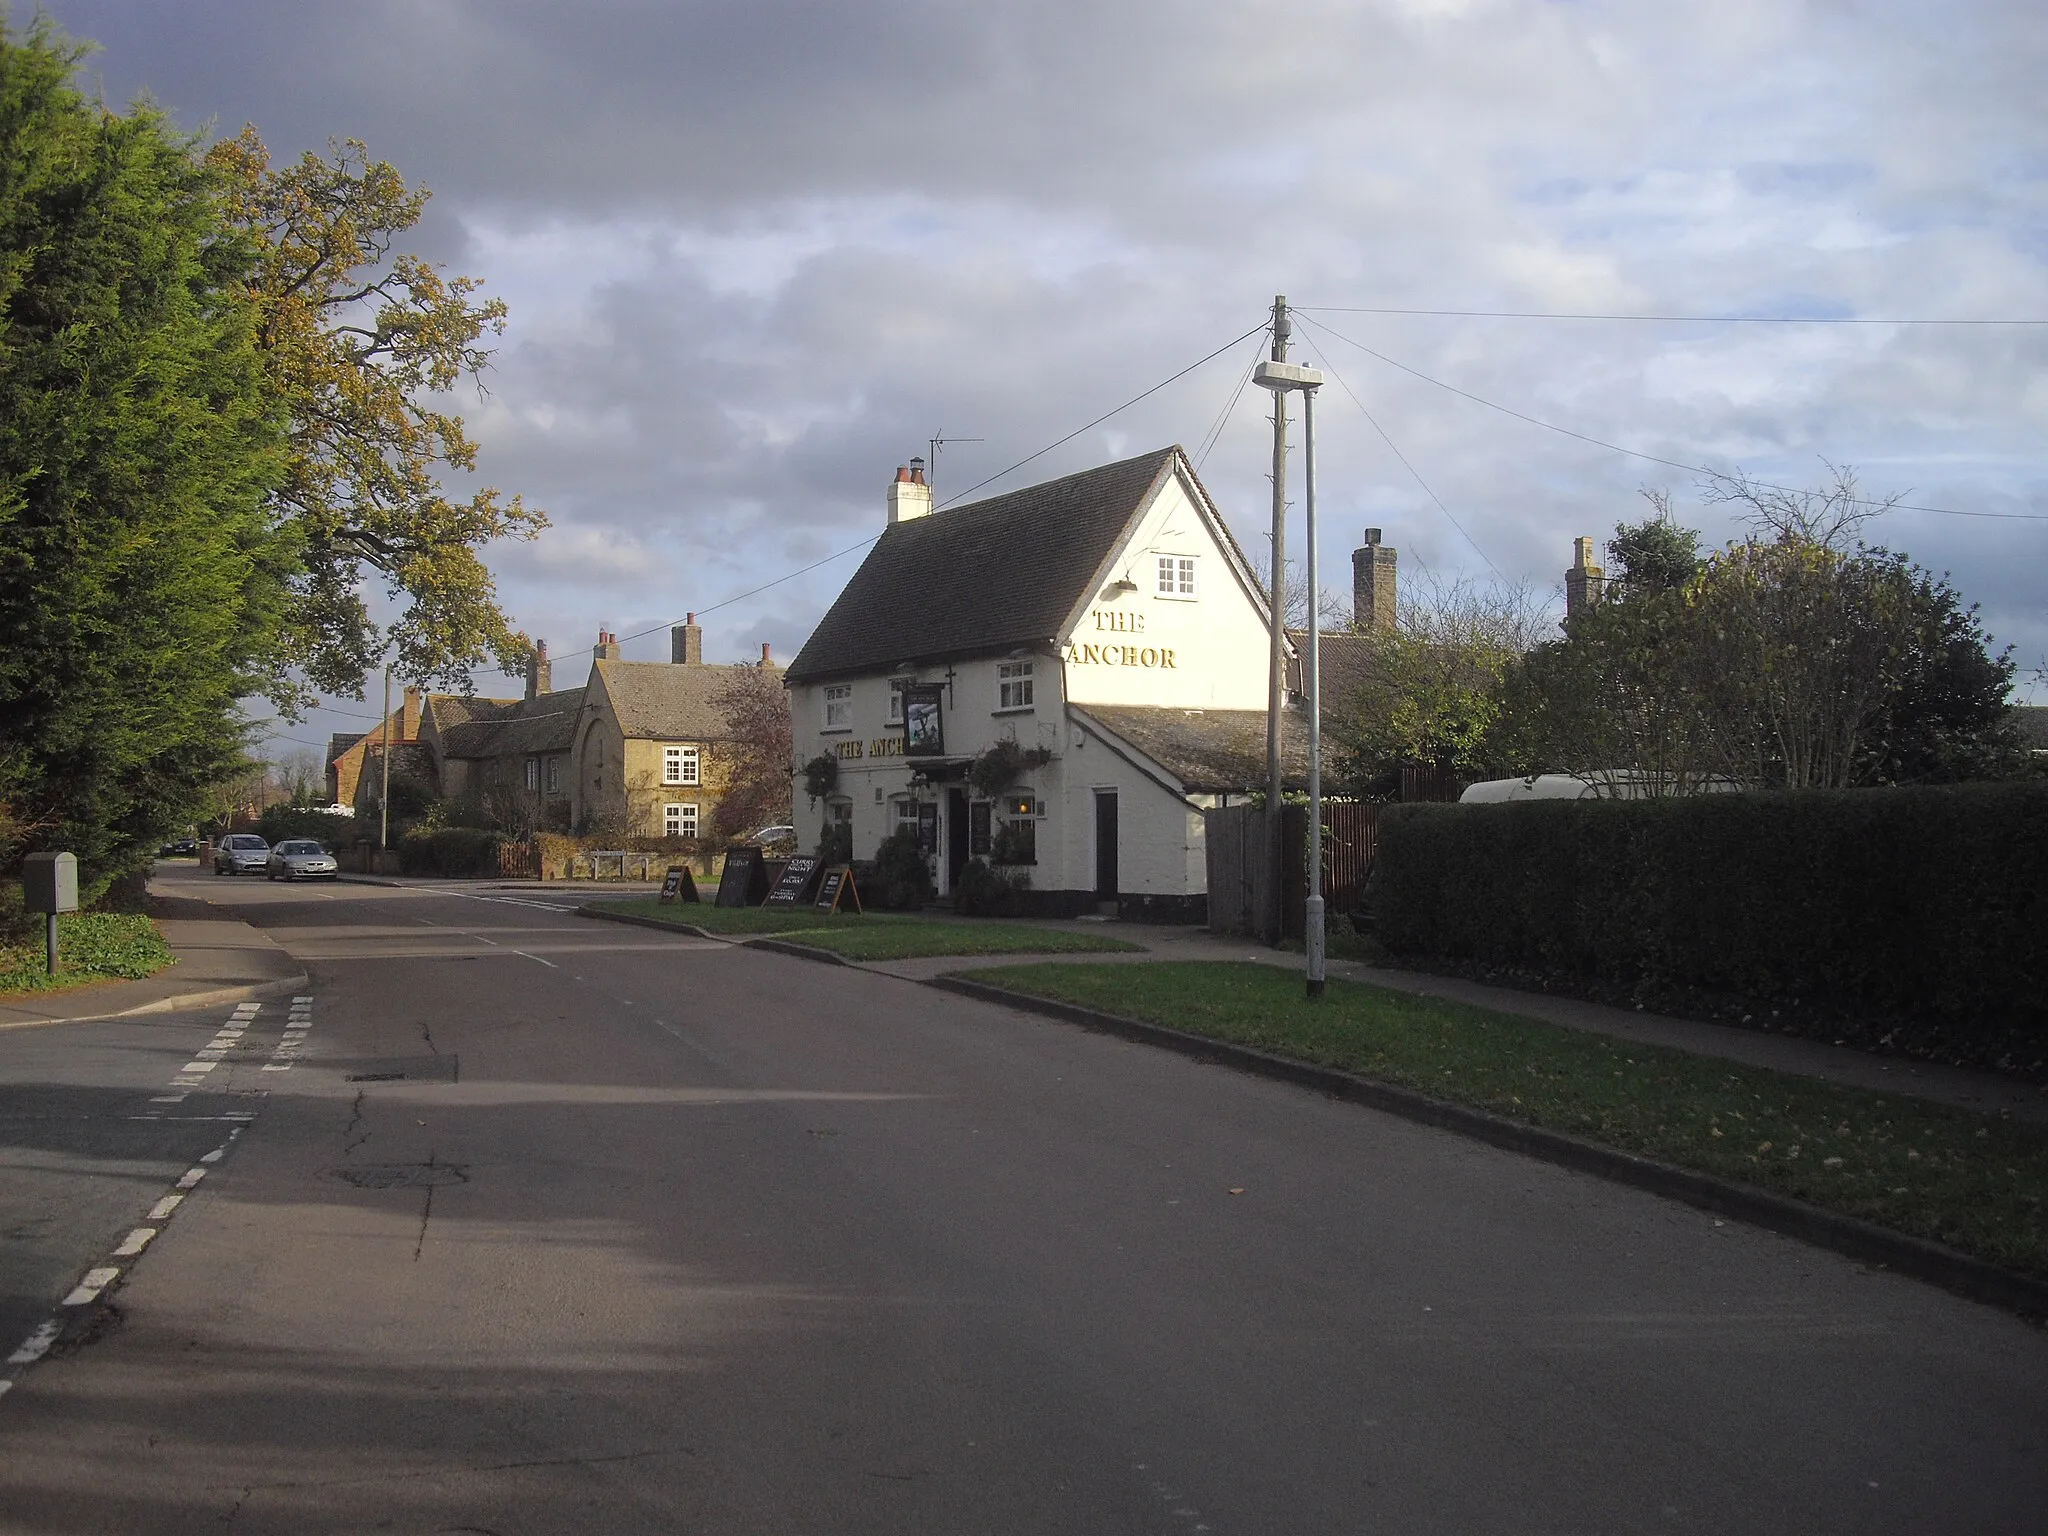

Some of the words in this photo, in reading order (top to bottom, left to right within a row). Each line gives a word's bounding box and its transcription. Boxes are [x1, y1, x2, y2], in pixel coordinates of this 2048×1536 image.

[1092, 609, 1145, 633] THE
[1066, 642, 1177, 669] ANCHOR
[836, 740, 863, 759] THE
[869, 736, 904, 757] ANCH
